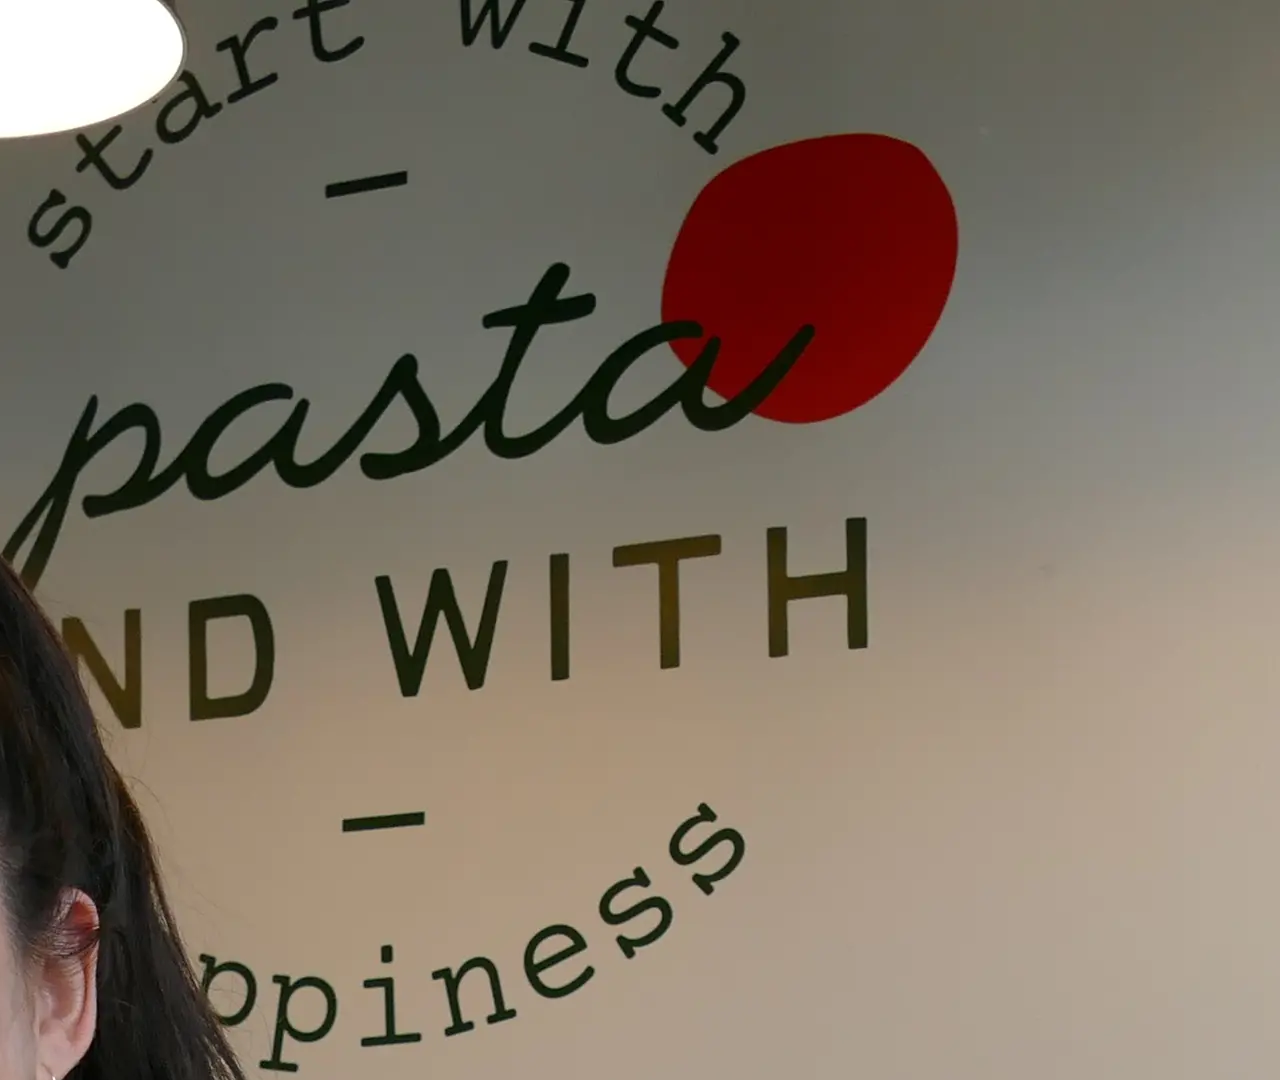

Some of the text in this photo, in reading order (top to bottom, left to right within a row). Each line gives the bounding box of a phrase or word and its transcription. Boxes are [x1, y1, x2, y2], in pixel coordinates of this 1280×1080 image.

[27, 0, 746, 270] start with
[0, 262, 816, 594] pasta
[61, 516, 869, 730] ND WITH
[198, 802, 747, 1073] ppiness
